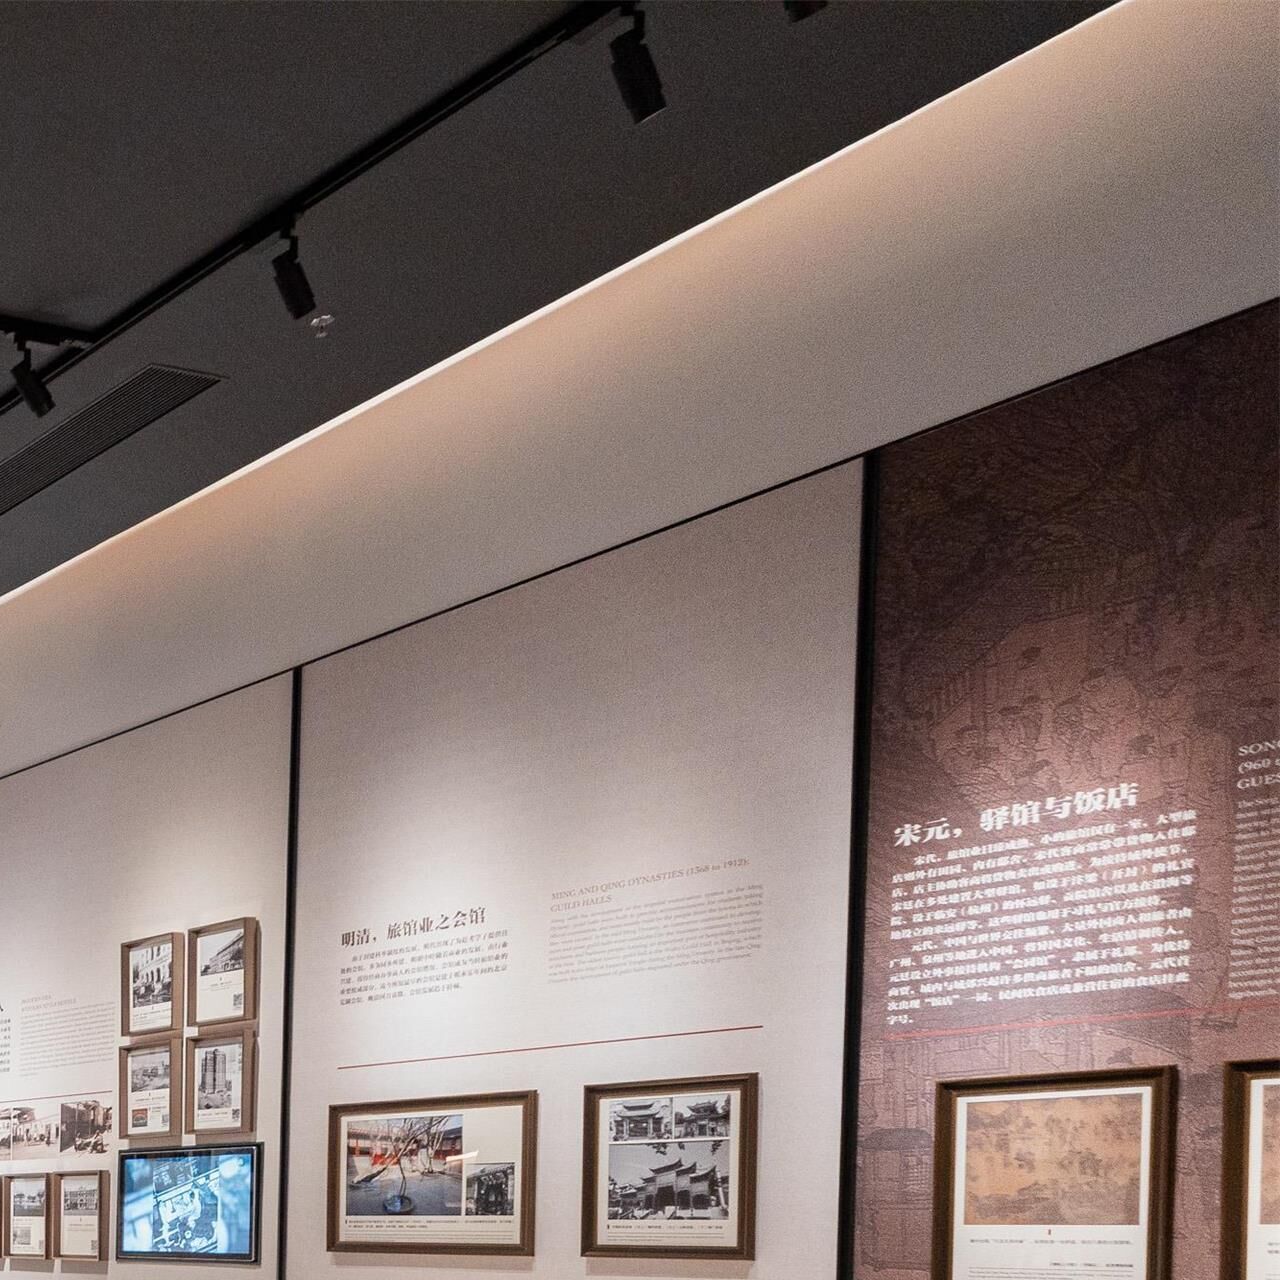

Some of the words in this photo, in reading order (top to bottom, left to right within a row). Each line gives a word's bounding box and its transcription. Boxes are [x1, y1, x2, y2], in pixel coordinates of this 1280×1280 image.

[1238, 740, 1280, 756] SON
[894, 783, 1139, 847] 宋元，驿馆与饭店
[627, 868, 685, 887] DYNASTIES
[582, 894, 613, 908] HALLS
[341, 906, 486, 948] 明清，旅馆业之会馆
